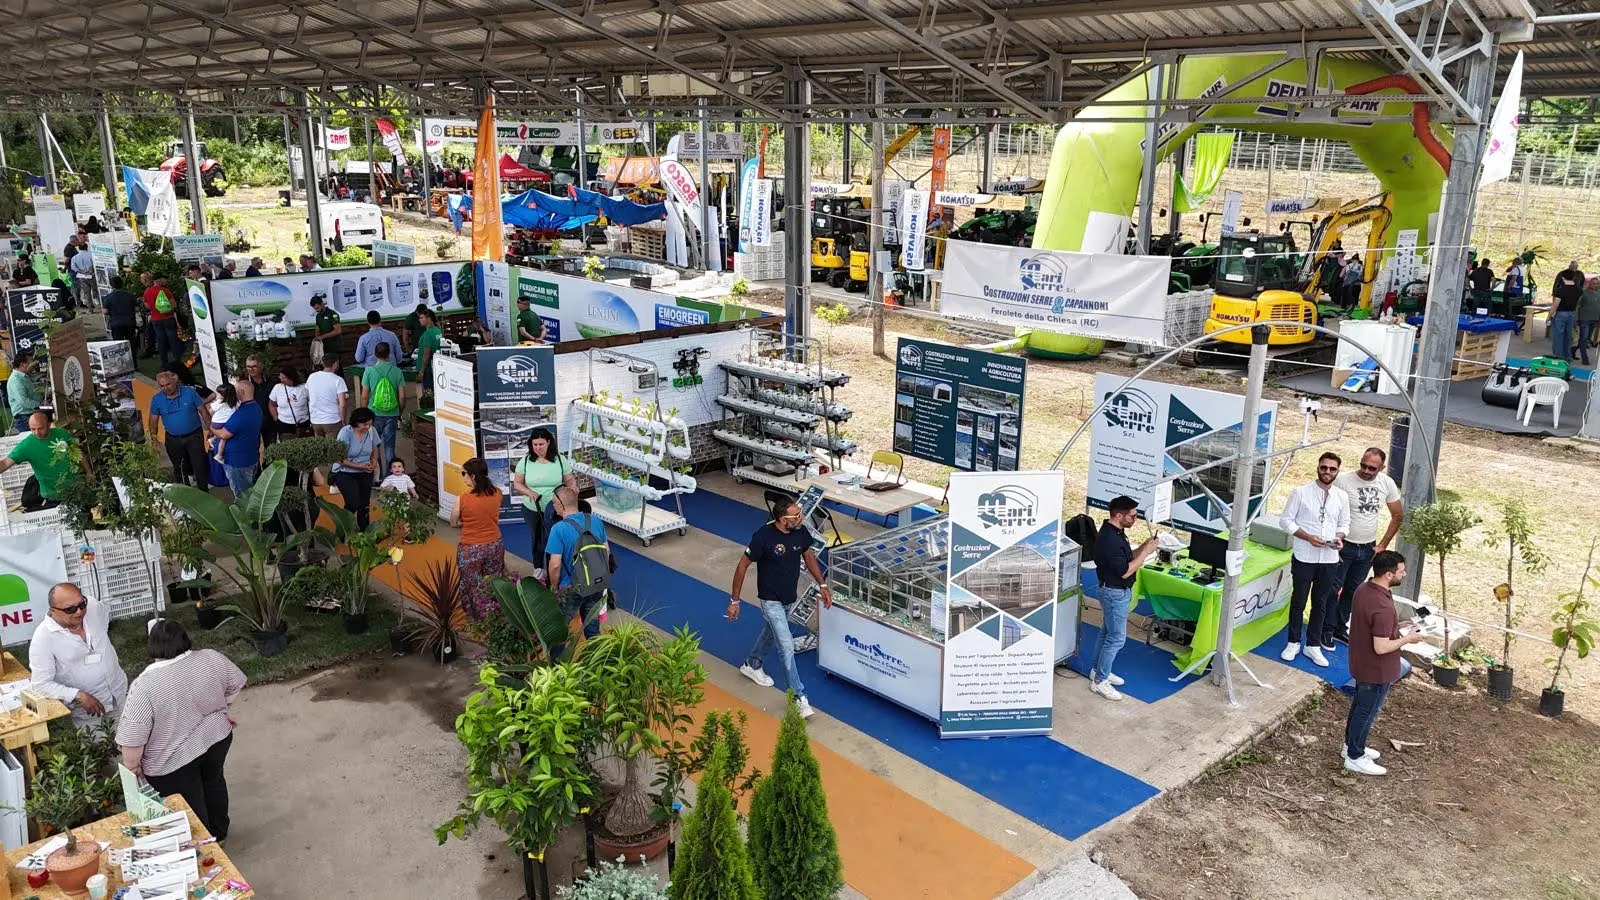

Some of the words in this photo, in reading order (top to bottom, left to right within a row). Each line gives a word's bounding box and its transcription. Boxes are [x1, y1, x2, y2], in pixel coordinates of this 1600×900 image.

[667, 163, 697, 203] BOSCO
[993, 183, 1026, 193] KOMATSU
[811, 185, 838, 195] KOMATSU
[940, 195, 975, 205] KOMATSU
[1270, 201, 1302, 213] KOMATSU
[906, 214, 918, 267] KOMATSU
[1030, 294, 1053, 307] SERRE
[1051, 295, 1064, 314] &
[1064, 299, 1109, 311] CAPANNONI
[587, 303, 621, 321] LENTINI
[658, 307, 705, 325] EMOGREEN
[991, 306, 1023, 319] Feroleto
[1024, 311, 1045, 321] della
[1047, 314, 1077, 326] Chiesa
[1080, 318, 1100, 329] (RC)
[1215, 312, 1250, 324] KOMATSU
[987, 361, 1022, 373] INNOVAZIONE
[988, 369, 1022, 380] AGRICOLTURA
[1169, 417, 1205, 430] Costruzioni
[1176, 425, 1195, 435] Serre
[953, 543, 992, 552] Costruzioni
[961, 551, 982, 559] Serre
